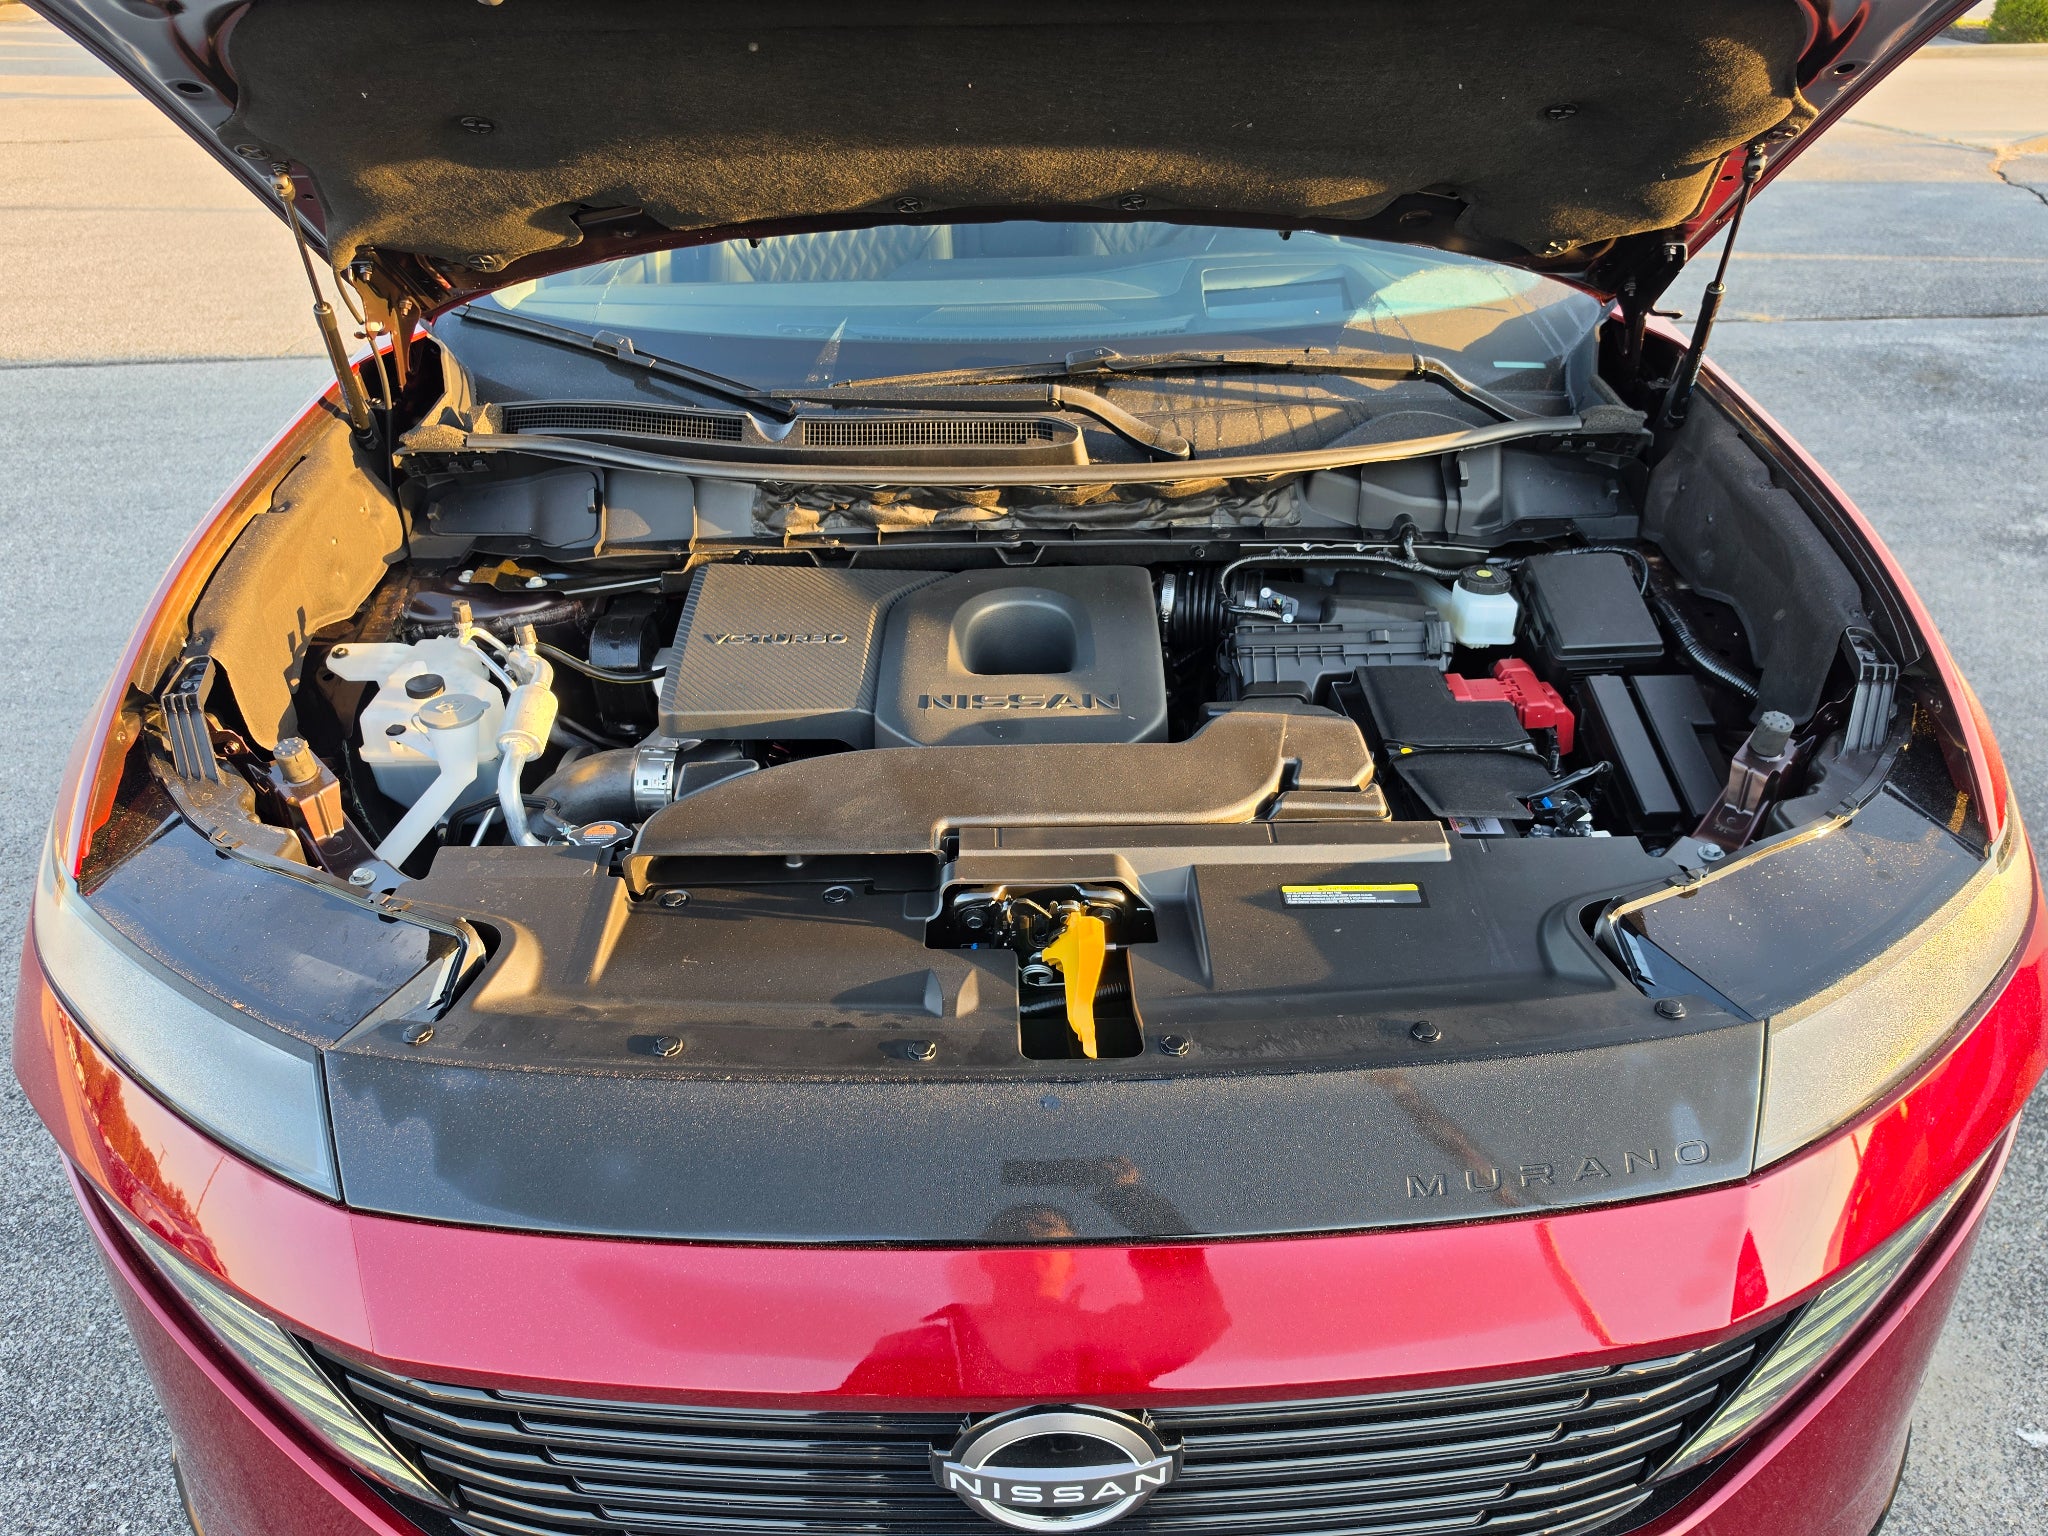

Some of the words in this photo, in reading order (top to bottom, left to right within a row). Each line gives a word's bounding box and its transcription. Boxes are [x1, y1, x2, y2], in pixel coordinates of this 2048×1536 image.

[704, 633, 848, 645] VC-TURBO
[922, 693, 1120, 710] NISSAN
[1406, 1138, 1710, 1199] MURANO
[949, 1466, 1166, 1504] NISSAN
